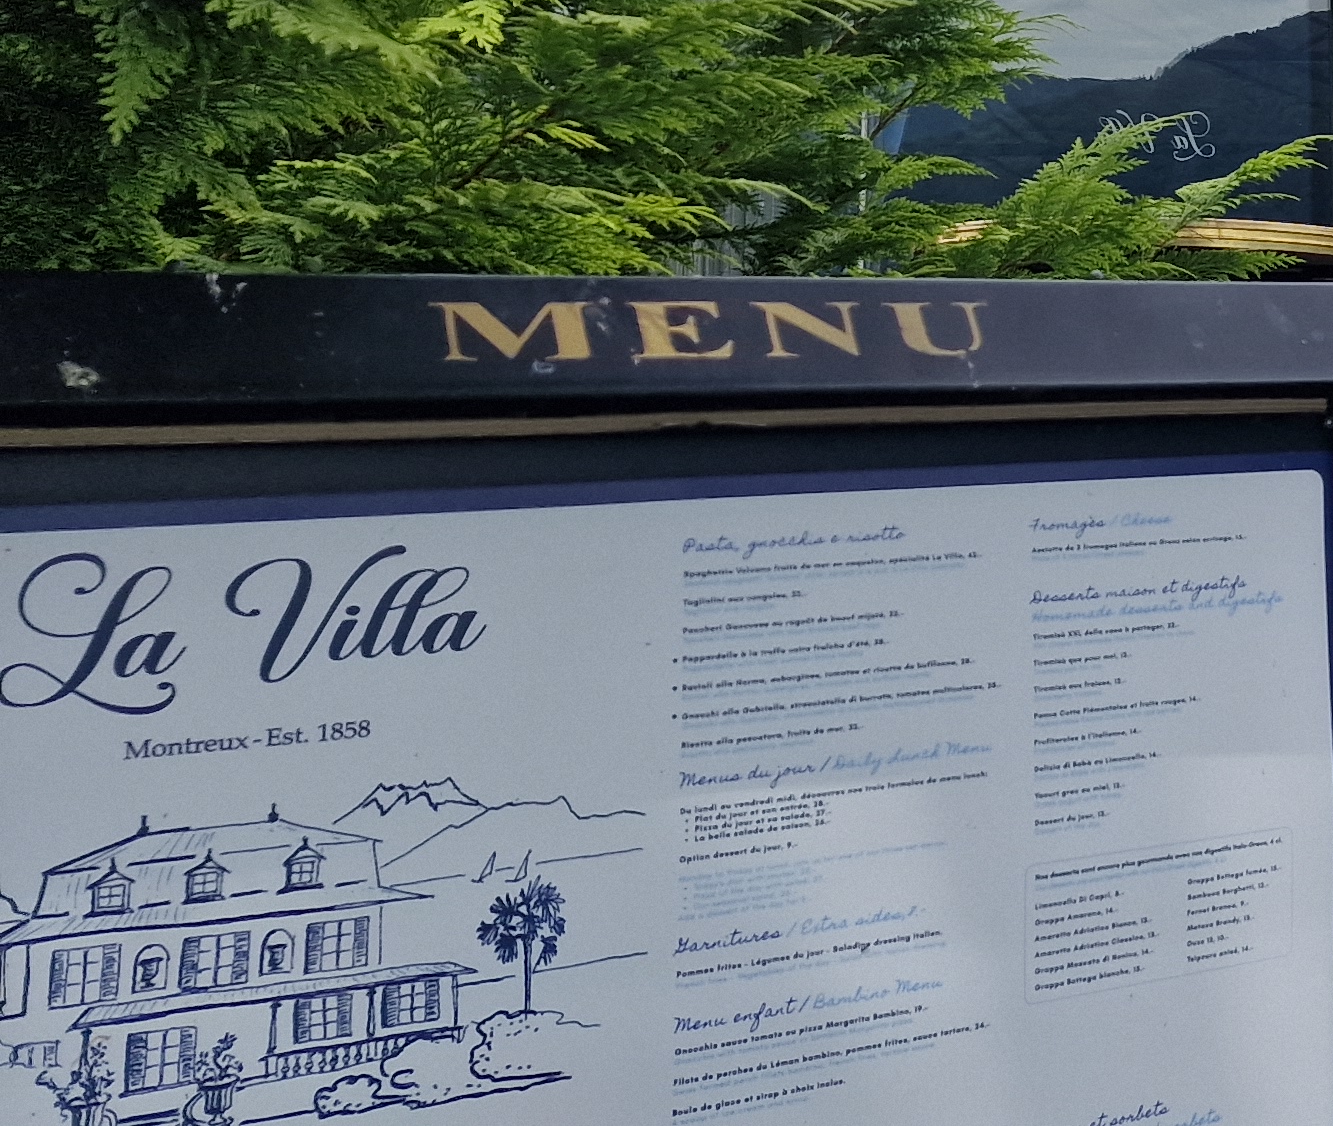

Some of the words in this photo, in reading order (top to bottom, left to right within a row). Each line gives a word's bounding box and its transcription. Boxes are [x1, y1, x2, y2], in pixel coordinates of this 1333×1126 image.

[428, 301, 988, 362] MENU
[0, 552, 187, 715] La
[225, 545, 487, 684] Villa
[318, 720, 371, 742] 1858
[679, 772, 742, 788] Menus
[673, 1017, 727, 1034] Menu
[733, 997, 798, 1032] enfant
[1110, 1100, 1169, 1126] sorbets
